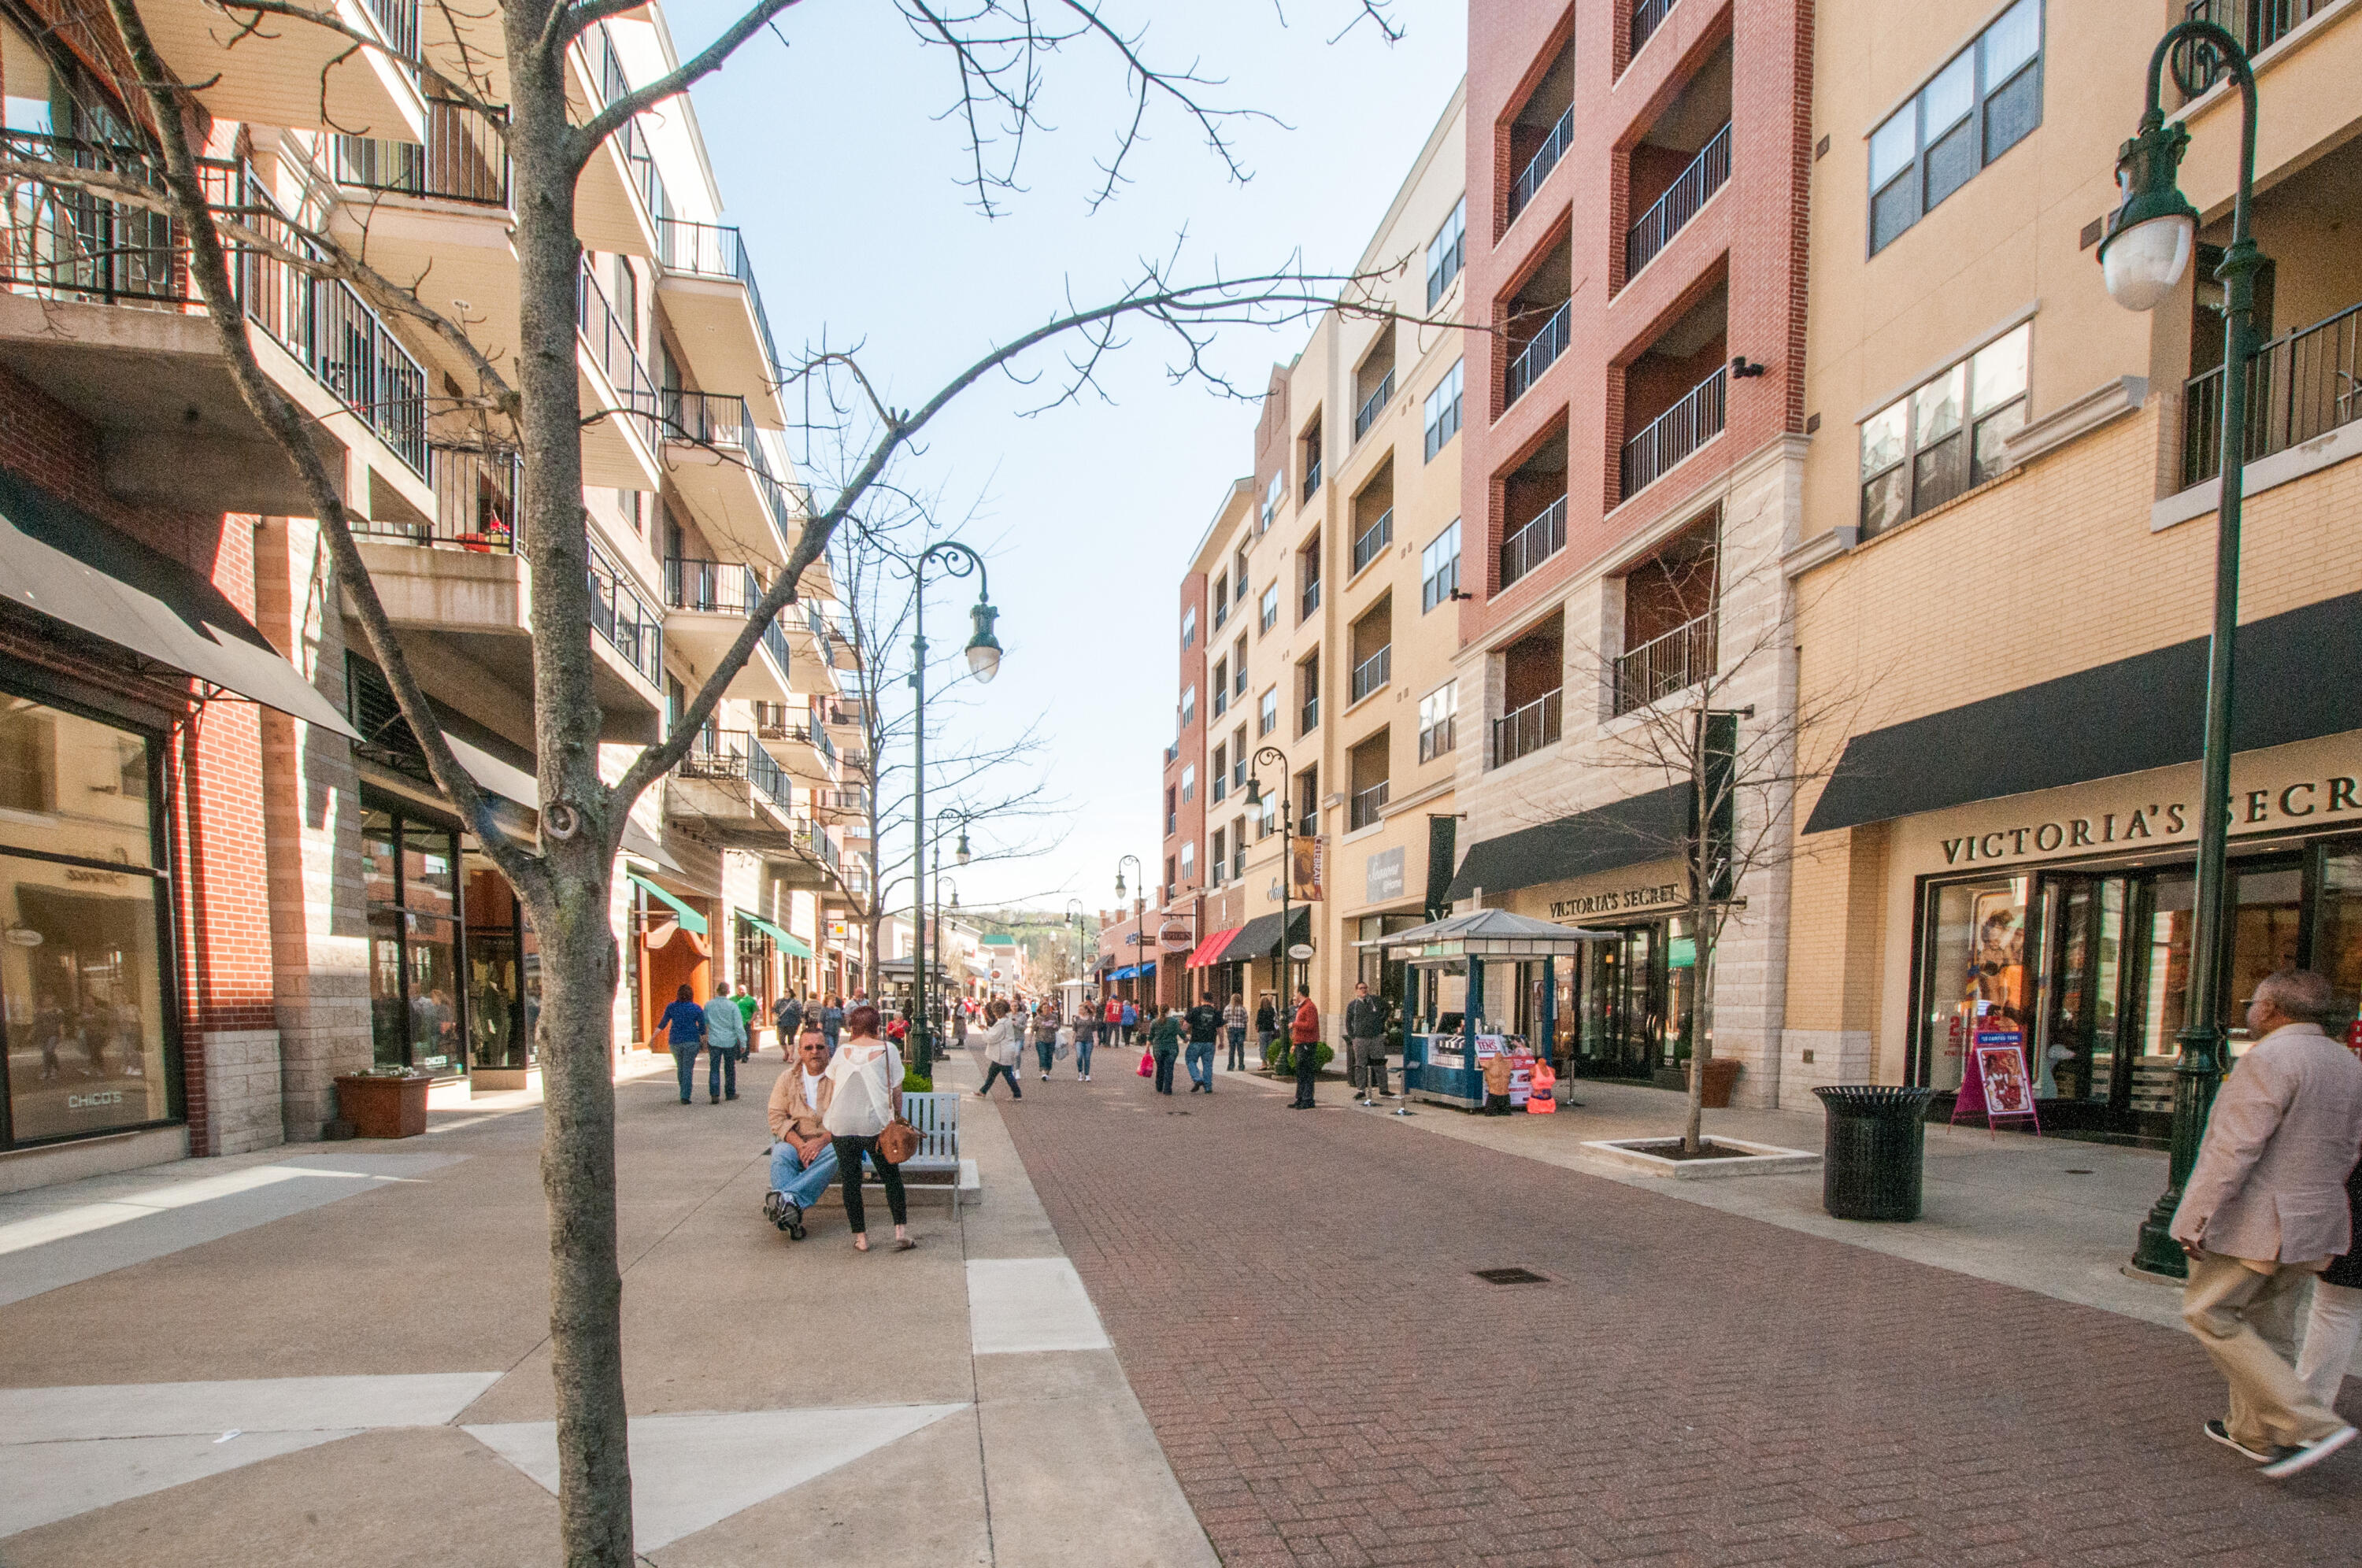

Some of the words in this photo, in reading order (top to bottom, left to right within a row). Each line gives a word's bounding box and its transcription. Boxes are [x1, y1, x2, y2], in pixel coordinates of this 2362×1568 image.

[1940, 804, 2185, 864] VICTORIA'S
[2227, 776, 2362, 827] ECR
[1314, 837, 1323, 886] CELEBRATE
[1368, 862, 1399, 882] Seasons
[1549, 893, 1618, 918] VICTORIA'S
[1623, 883, 1679, 908] SECRET
[1113, 1005, 1120, 1015] 11
[1476, 1041, 1498, 1051] TENS
[68, 1090, 123, 1108] CHICO'S
